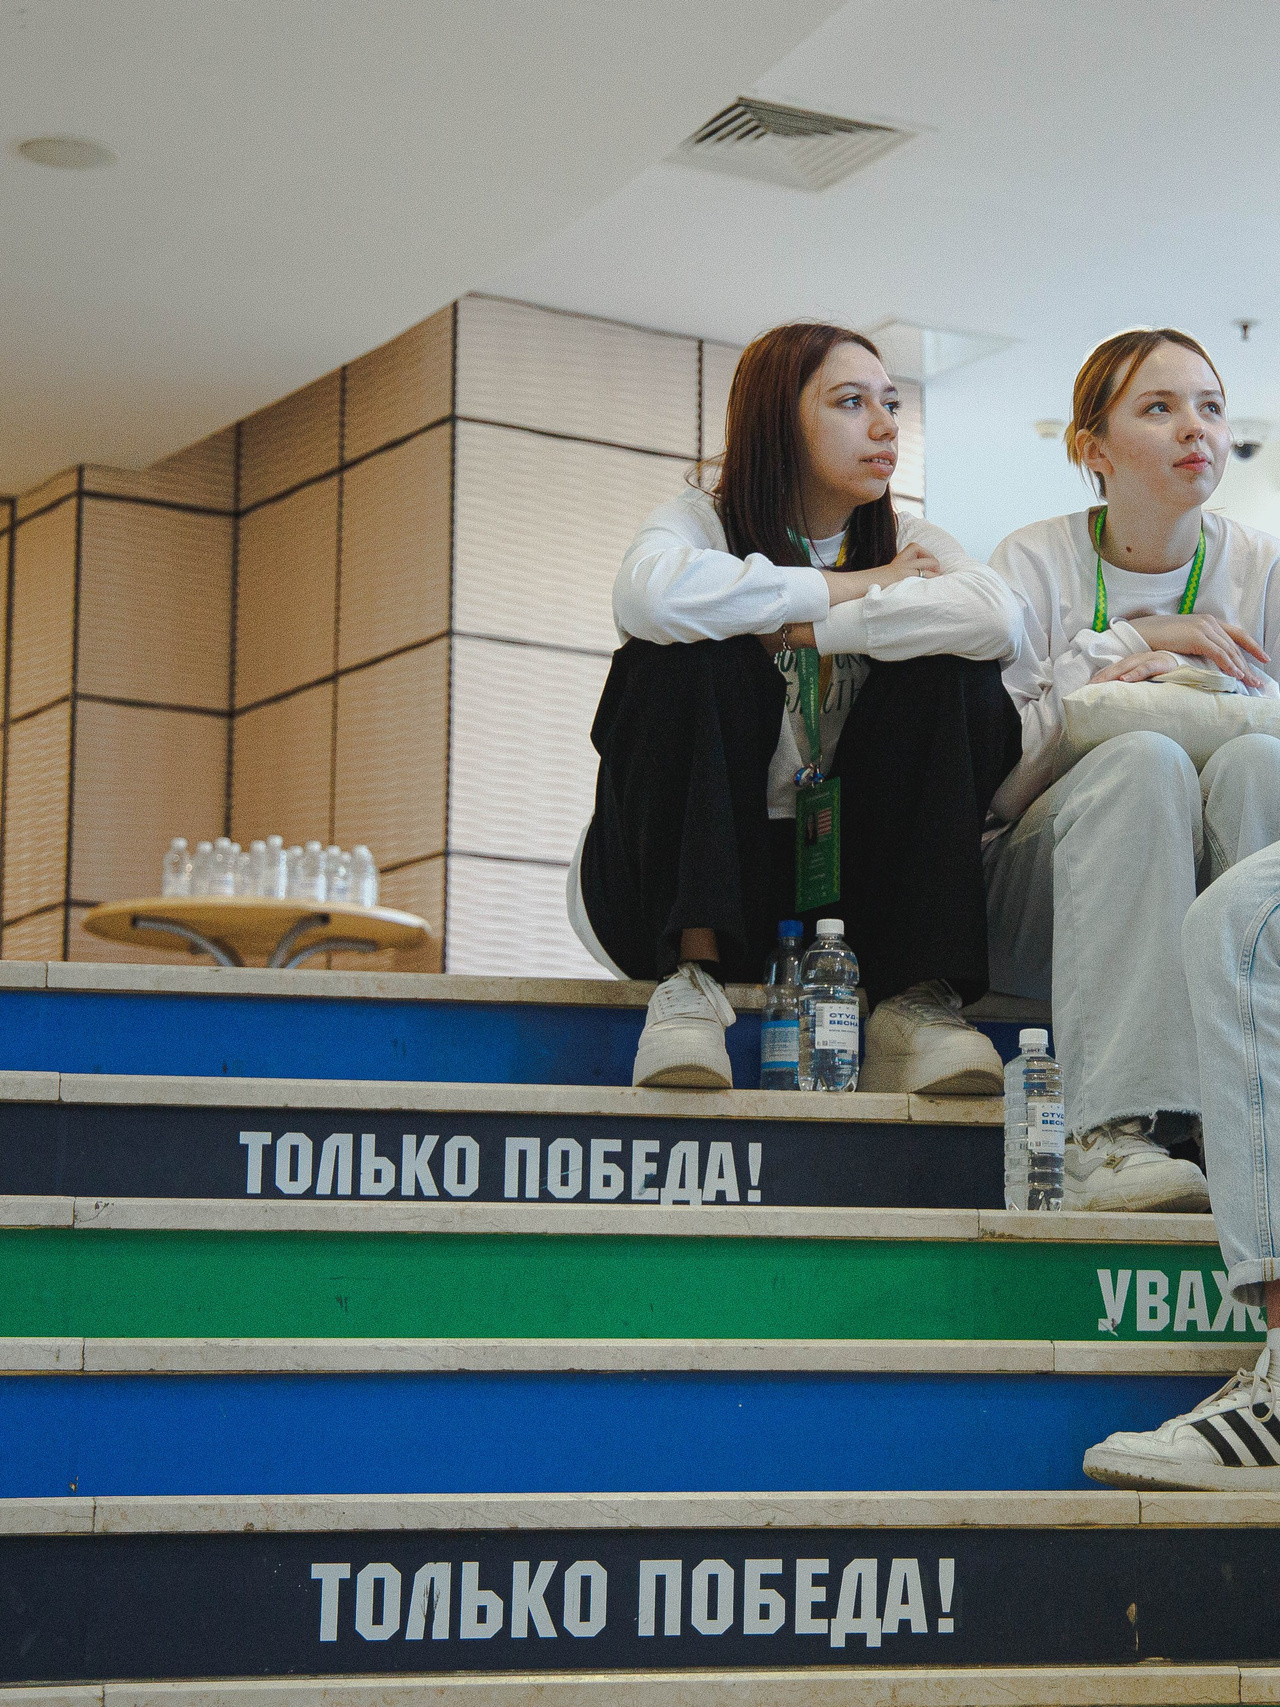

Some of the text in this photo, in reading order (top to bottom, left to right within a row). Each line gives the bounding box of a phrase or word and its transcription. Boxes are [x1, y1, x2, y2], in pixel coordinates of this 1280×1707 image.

[240, 1131, 762, 1205] ТОЛЬКО ПОБЕДА!
[1096, 1269, 1267, 1333] УВАЖ
[310, 1558, 955, 1648] ТОЛЬКО ПОБЕДА!
